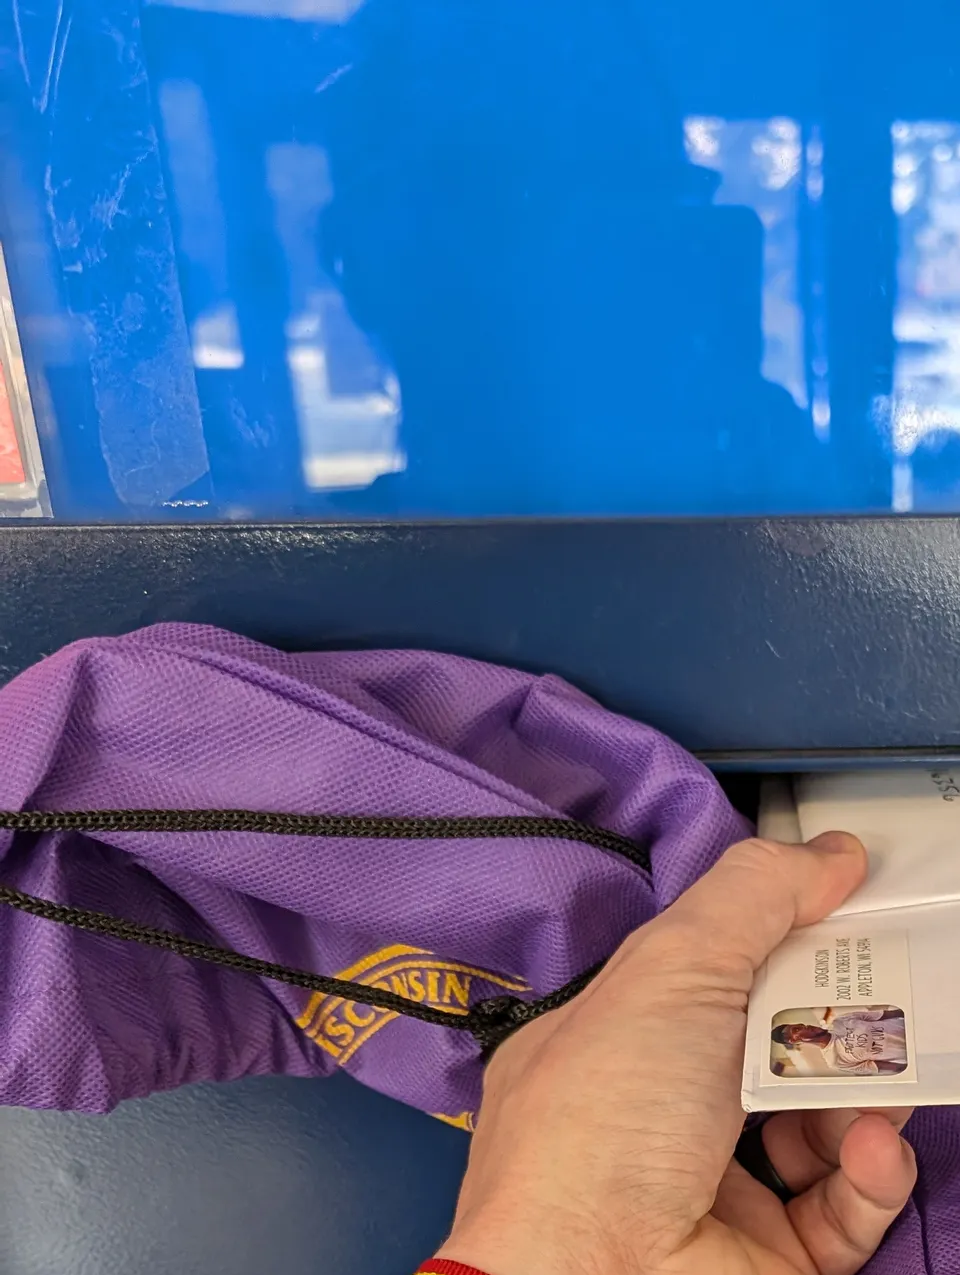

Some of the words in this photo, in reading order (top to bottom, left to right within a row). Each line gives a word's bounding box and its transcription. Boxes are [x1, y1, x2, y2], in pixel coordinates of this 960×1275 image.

[836, 948, 851, 974] ROBERTS
[857, 953, 871, 962] WI
[814, 949, 830, 988] HODGKINSON
[836, 974, 851, 984] W.
[857, 962, 873, 997] APPLETON,
[836, 985, 851, 1001] 2002
[855, 1033, 868, 1048] KIDS
[870, 1041, 883, 1055] NOT
